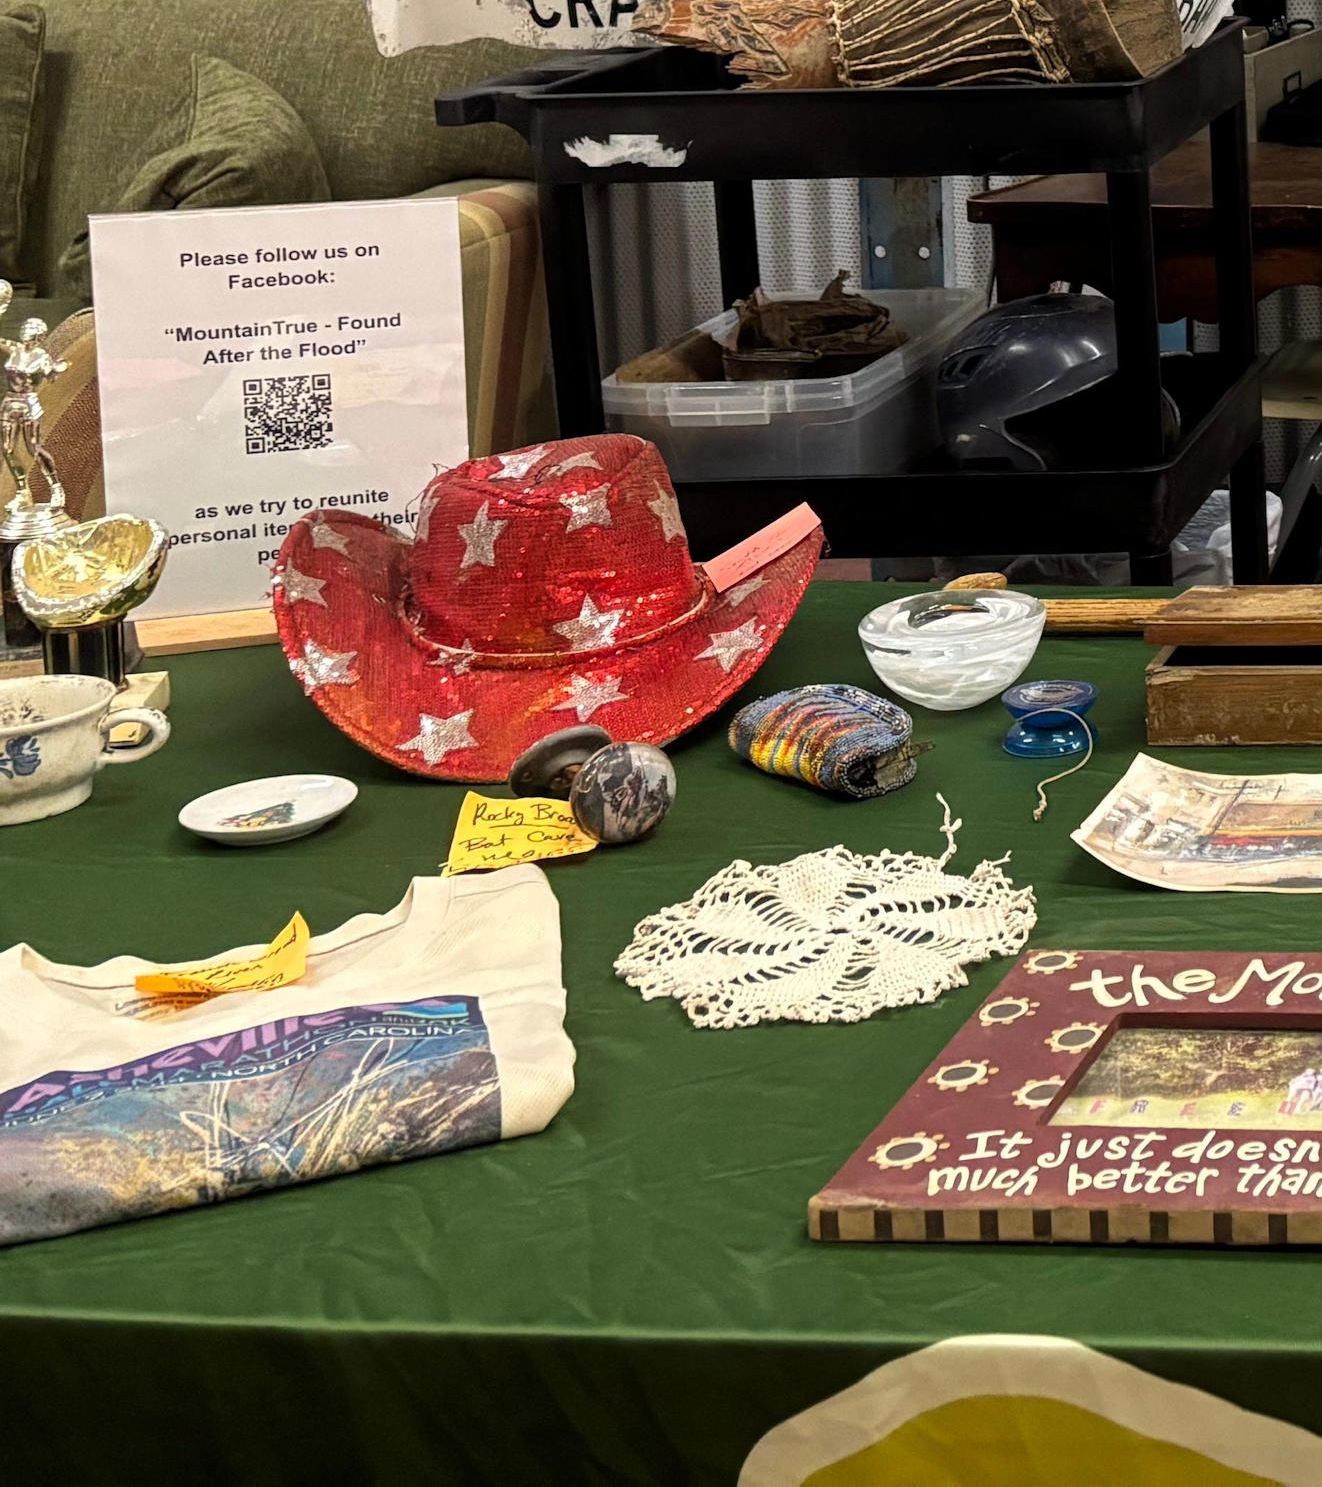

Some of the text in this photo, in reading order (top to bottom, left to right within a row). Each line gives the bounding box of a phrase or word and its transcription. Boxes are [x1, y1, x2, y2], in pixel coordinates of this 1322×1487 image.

[179, 243, 380, 268] Please follow us on
[228, 269, 336, 290] Facebook:
[337, 313, 402, 332] Found
[203, 346, 254, 365] After
[260, 344, 293, 361] the
[194, 489, 389, 519] as we try to reunite
[168, 523, 256, 549] personal
[1069, 964, 1217, 1007] the
[212, 1044, 317, 1078] NORTH
[958, 1130, 1033, 1160] It
[1038, 1132, 1169, 1168] just
[928, 1164, 1038, 1196] much
[1066, 1161, 1219, 1197] better
